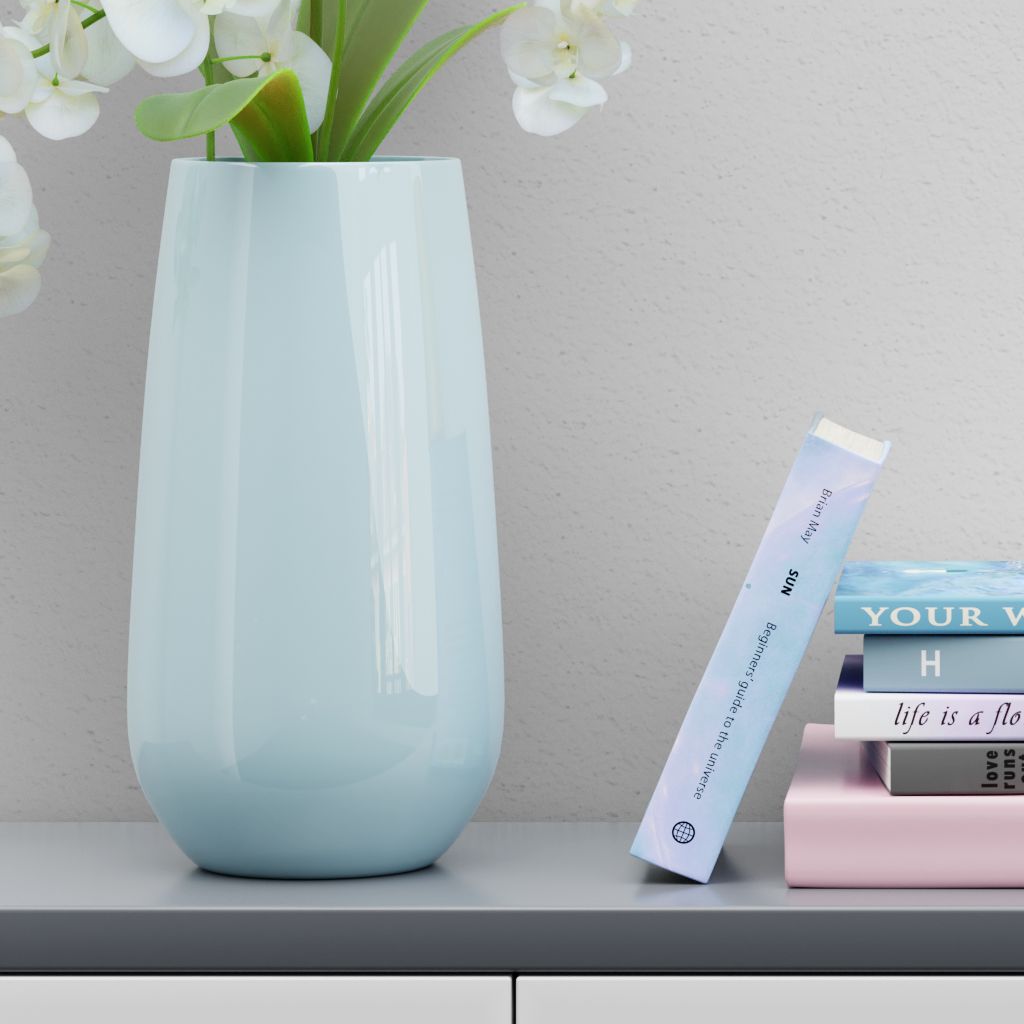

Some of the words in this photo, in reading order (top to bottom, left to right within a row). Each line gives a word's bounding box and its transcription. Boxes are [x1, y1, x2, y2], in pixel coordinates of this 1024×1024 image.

[812, 488, 833, 518] Brian
[800, 519, 820, 544] May
[781, 569, 799, 596] SUN
[861, 606, 988, 627] YOUR
[729, 681, 749, 714] guide
[723, 716, 735, 728] to
[894, 702, 930, 735] life
[940, 707, 958, 726] is
[969, 711, 984, 726] a
[714, 731, 729, 750] the
[694, 752, 719, 800] universe
[981, 750, 998, 788] love
[1004, 749, 1016, 789] runs
